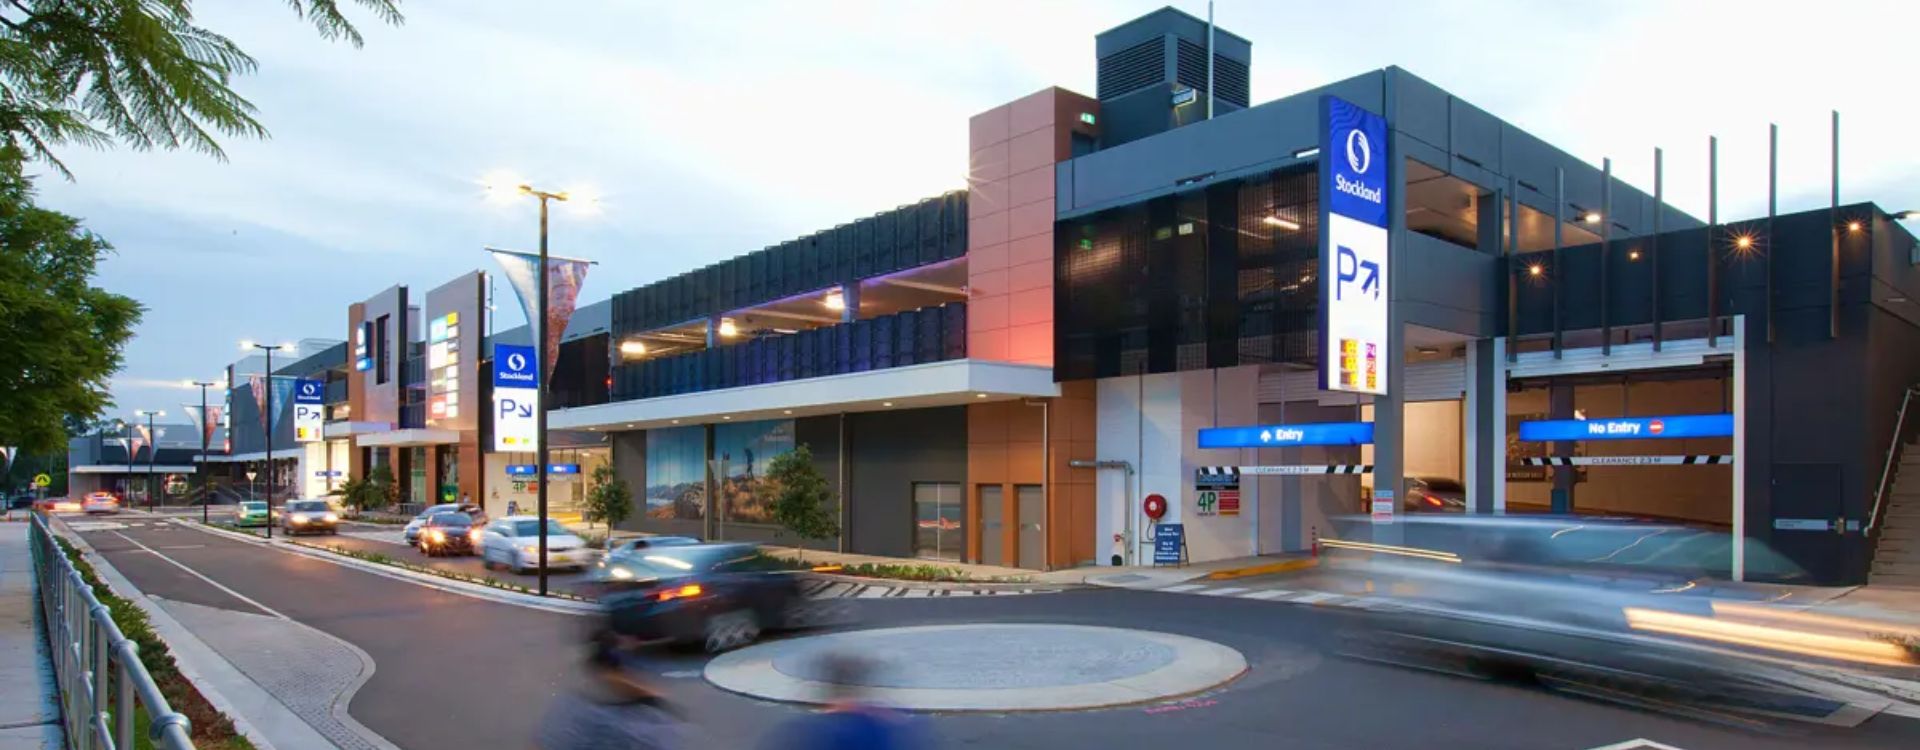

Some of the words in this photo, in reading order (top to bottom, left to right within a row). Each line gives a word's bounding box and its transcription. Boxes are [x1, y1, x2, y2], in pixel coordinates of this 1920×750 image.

[1335, 173, 1382, 204] Stockland
[1336, 244, 1358, 301] P
[499, 371, 534, 381] Stockland
[297, 406, 309, 420] P
[500, 398, 516, 419] P
[1276, 429, 1304, 441] Entry
[1588, 422, 1606, 434] No
[1607, 421, 1641, 435] Entry
[1591, 457, 1638, 465] CLEARANCE
[1198, 491, 1217, 512] 4P
